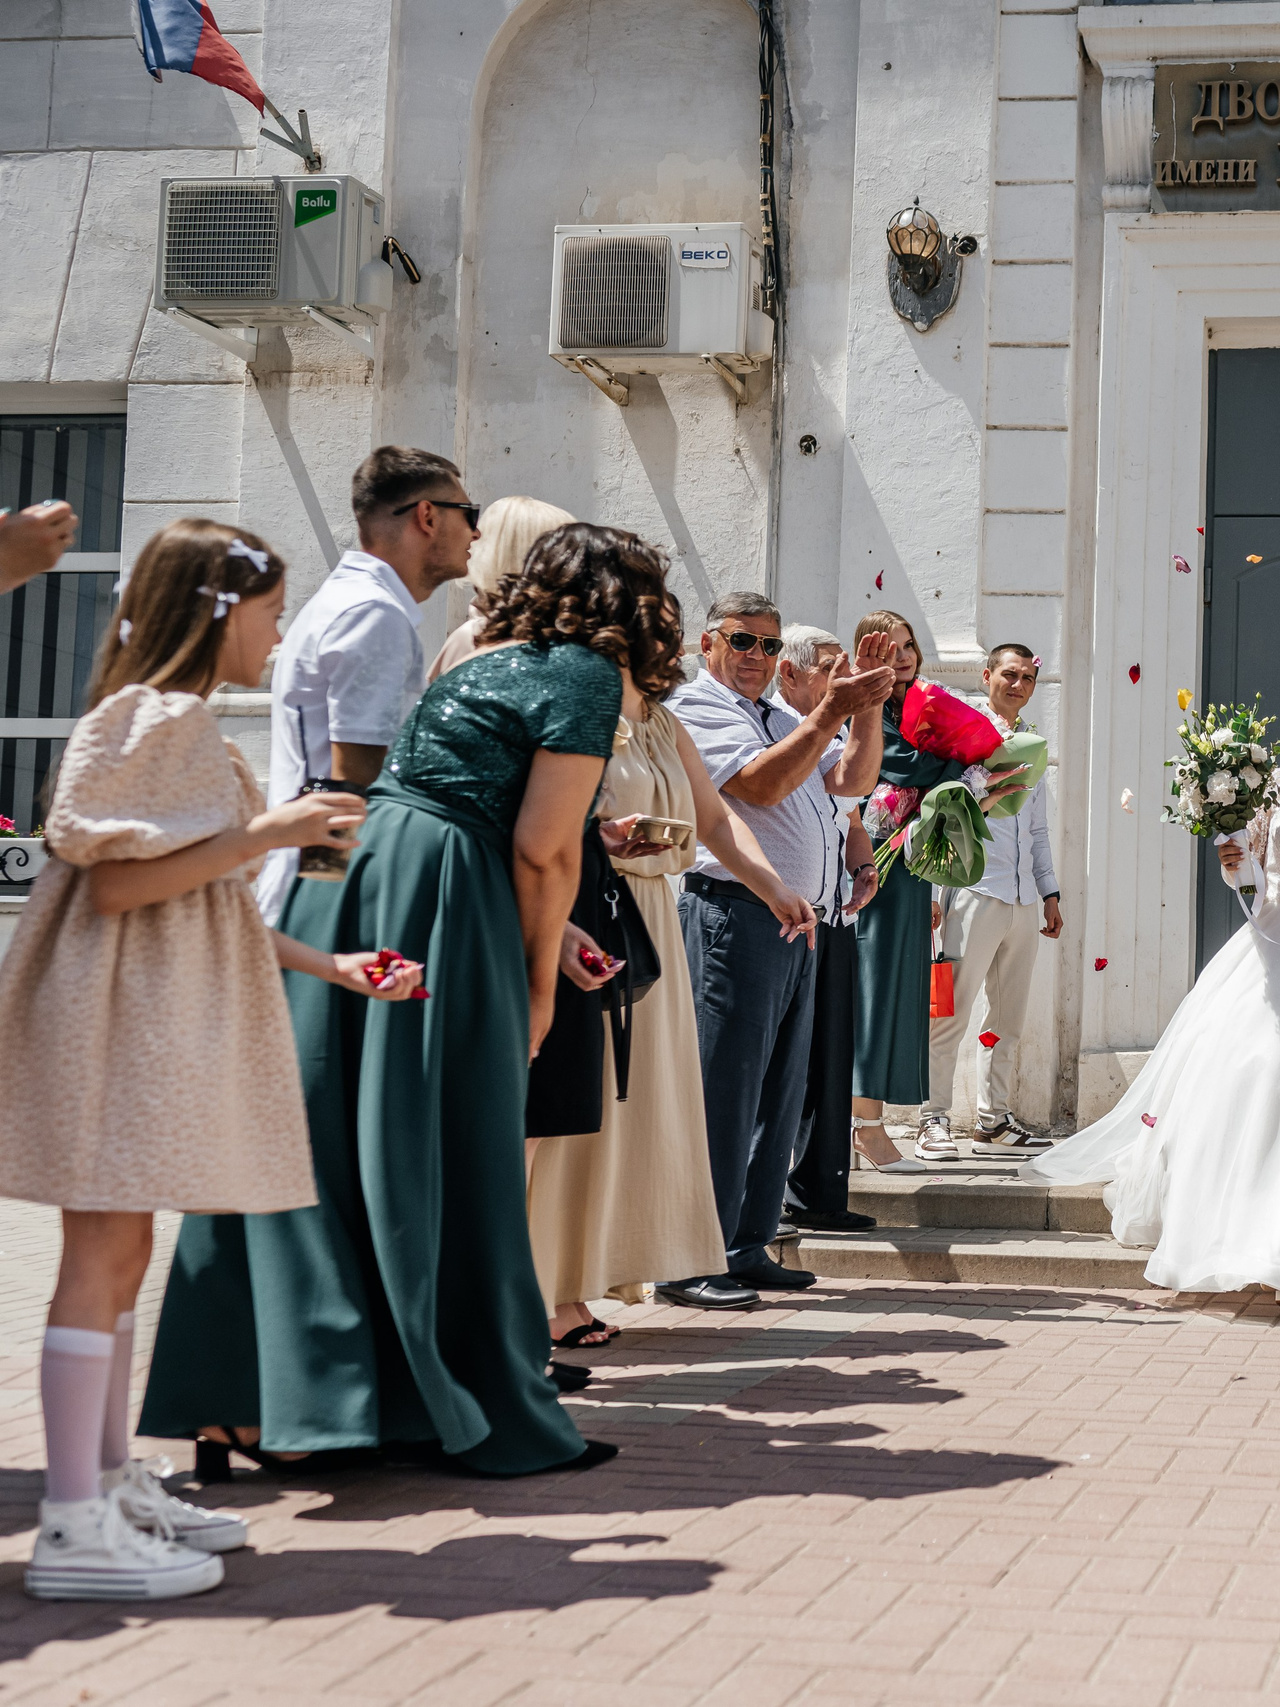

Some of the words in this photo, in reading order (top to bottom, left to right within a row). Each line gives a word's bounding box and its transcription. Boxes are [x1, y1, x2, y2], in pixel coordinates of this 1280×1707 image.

[1154, 159, 1257, 187] ИМЕНИ
[301, 195, 331, 208] Ballu
[681, 250, 729, 260] BEKO
